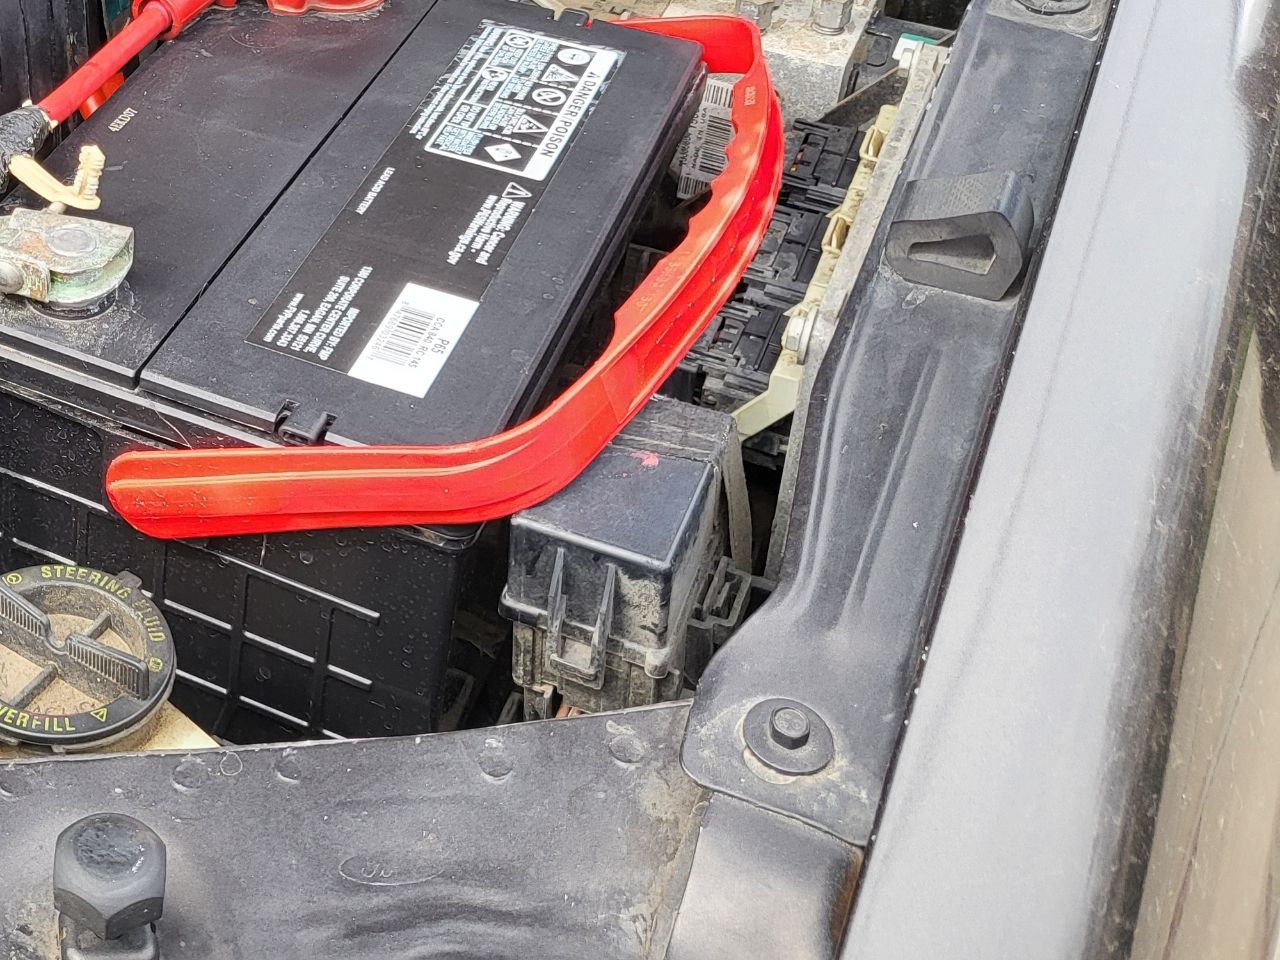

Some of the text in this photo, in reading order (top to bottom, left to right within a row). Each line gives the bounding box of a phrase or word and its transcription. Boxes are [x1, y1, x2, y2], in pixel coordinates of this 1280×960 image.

[355, 167, 395, 215] LEAD ACID BATTERY
[471, 197, 512, 249] Reproductive Harm
[475, 201, 526, 265] WARNING: Cancer and
[331, 276, 350, 294] SUITE
[334, 277, 364, 311] CORPORATE
[307, 302, 331, 325] EAGAN,
[319, 309, 342, 333] CENTER
[333, 307, 360, 337] IMPORTED
[429, 316, 448, 332] CCA
[303, 331, 326, 353] CURVE,
[325, 335, 340, 348] BY:
[413, 344, 429, 357] RC
[430, 337, 451, 355] P65
[406, 355, 422, 369] 145
[40, 565, 135, 600] STEERING
